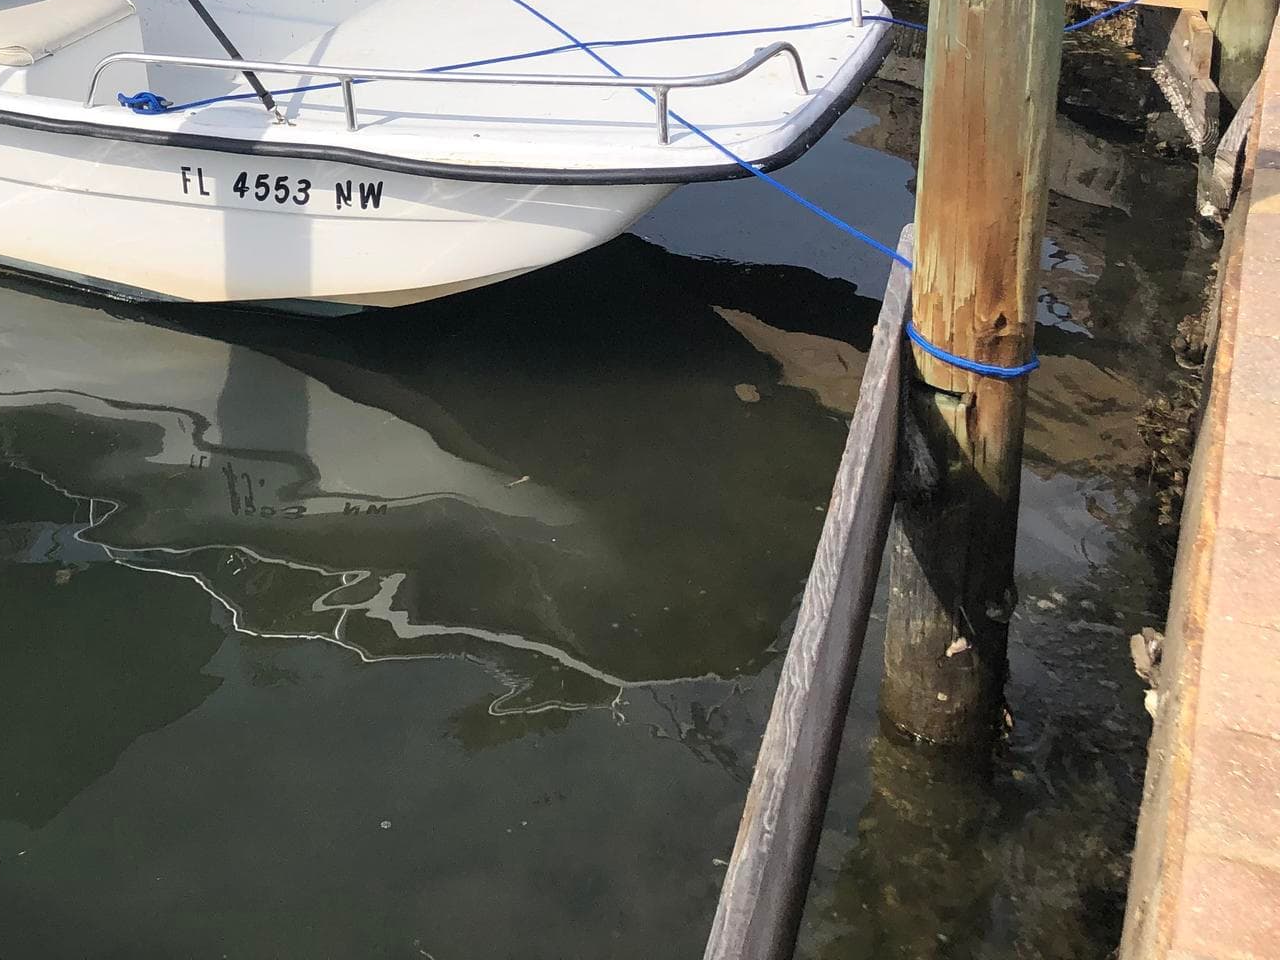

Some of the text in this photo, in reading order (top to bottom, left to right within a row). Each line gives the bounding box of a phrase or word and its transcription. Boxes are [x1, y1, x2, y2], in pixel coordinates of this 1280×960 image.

[181, 166, 384, 210] FL 4553 NW
